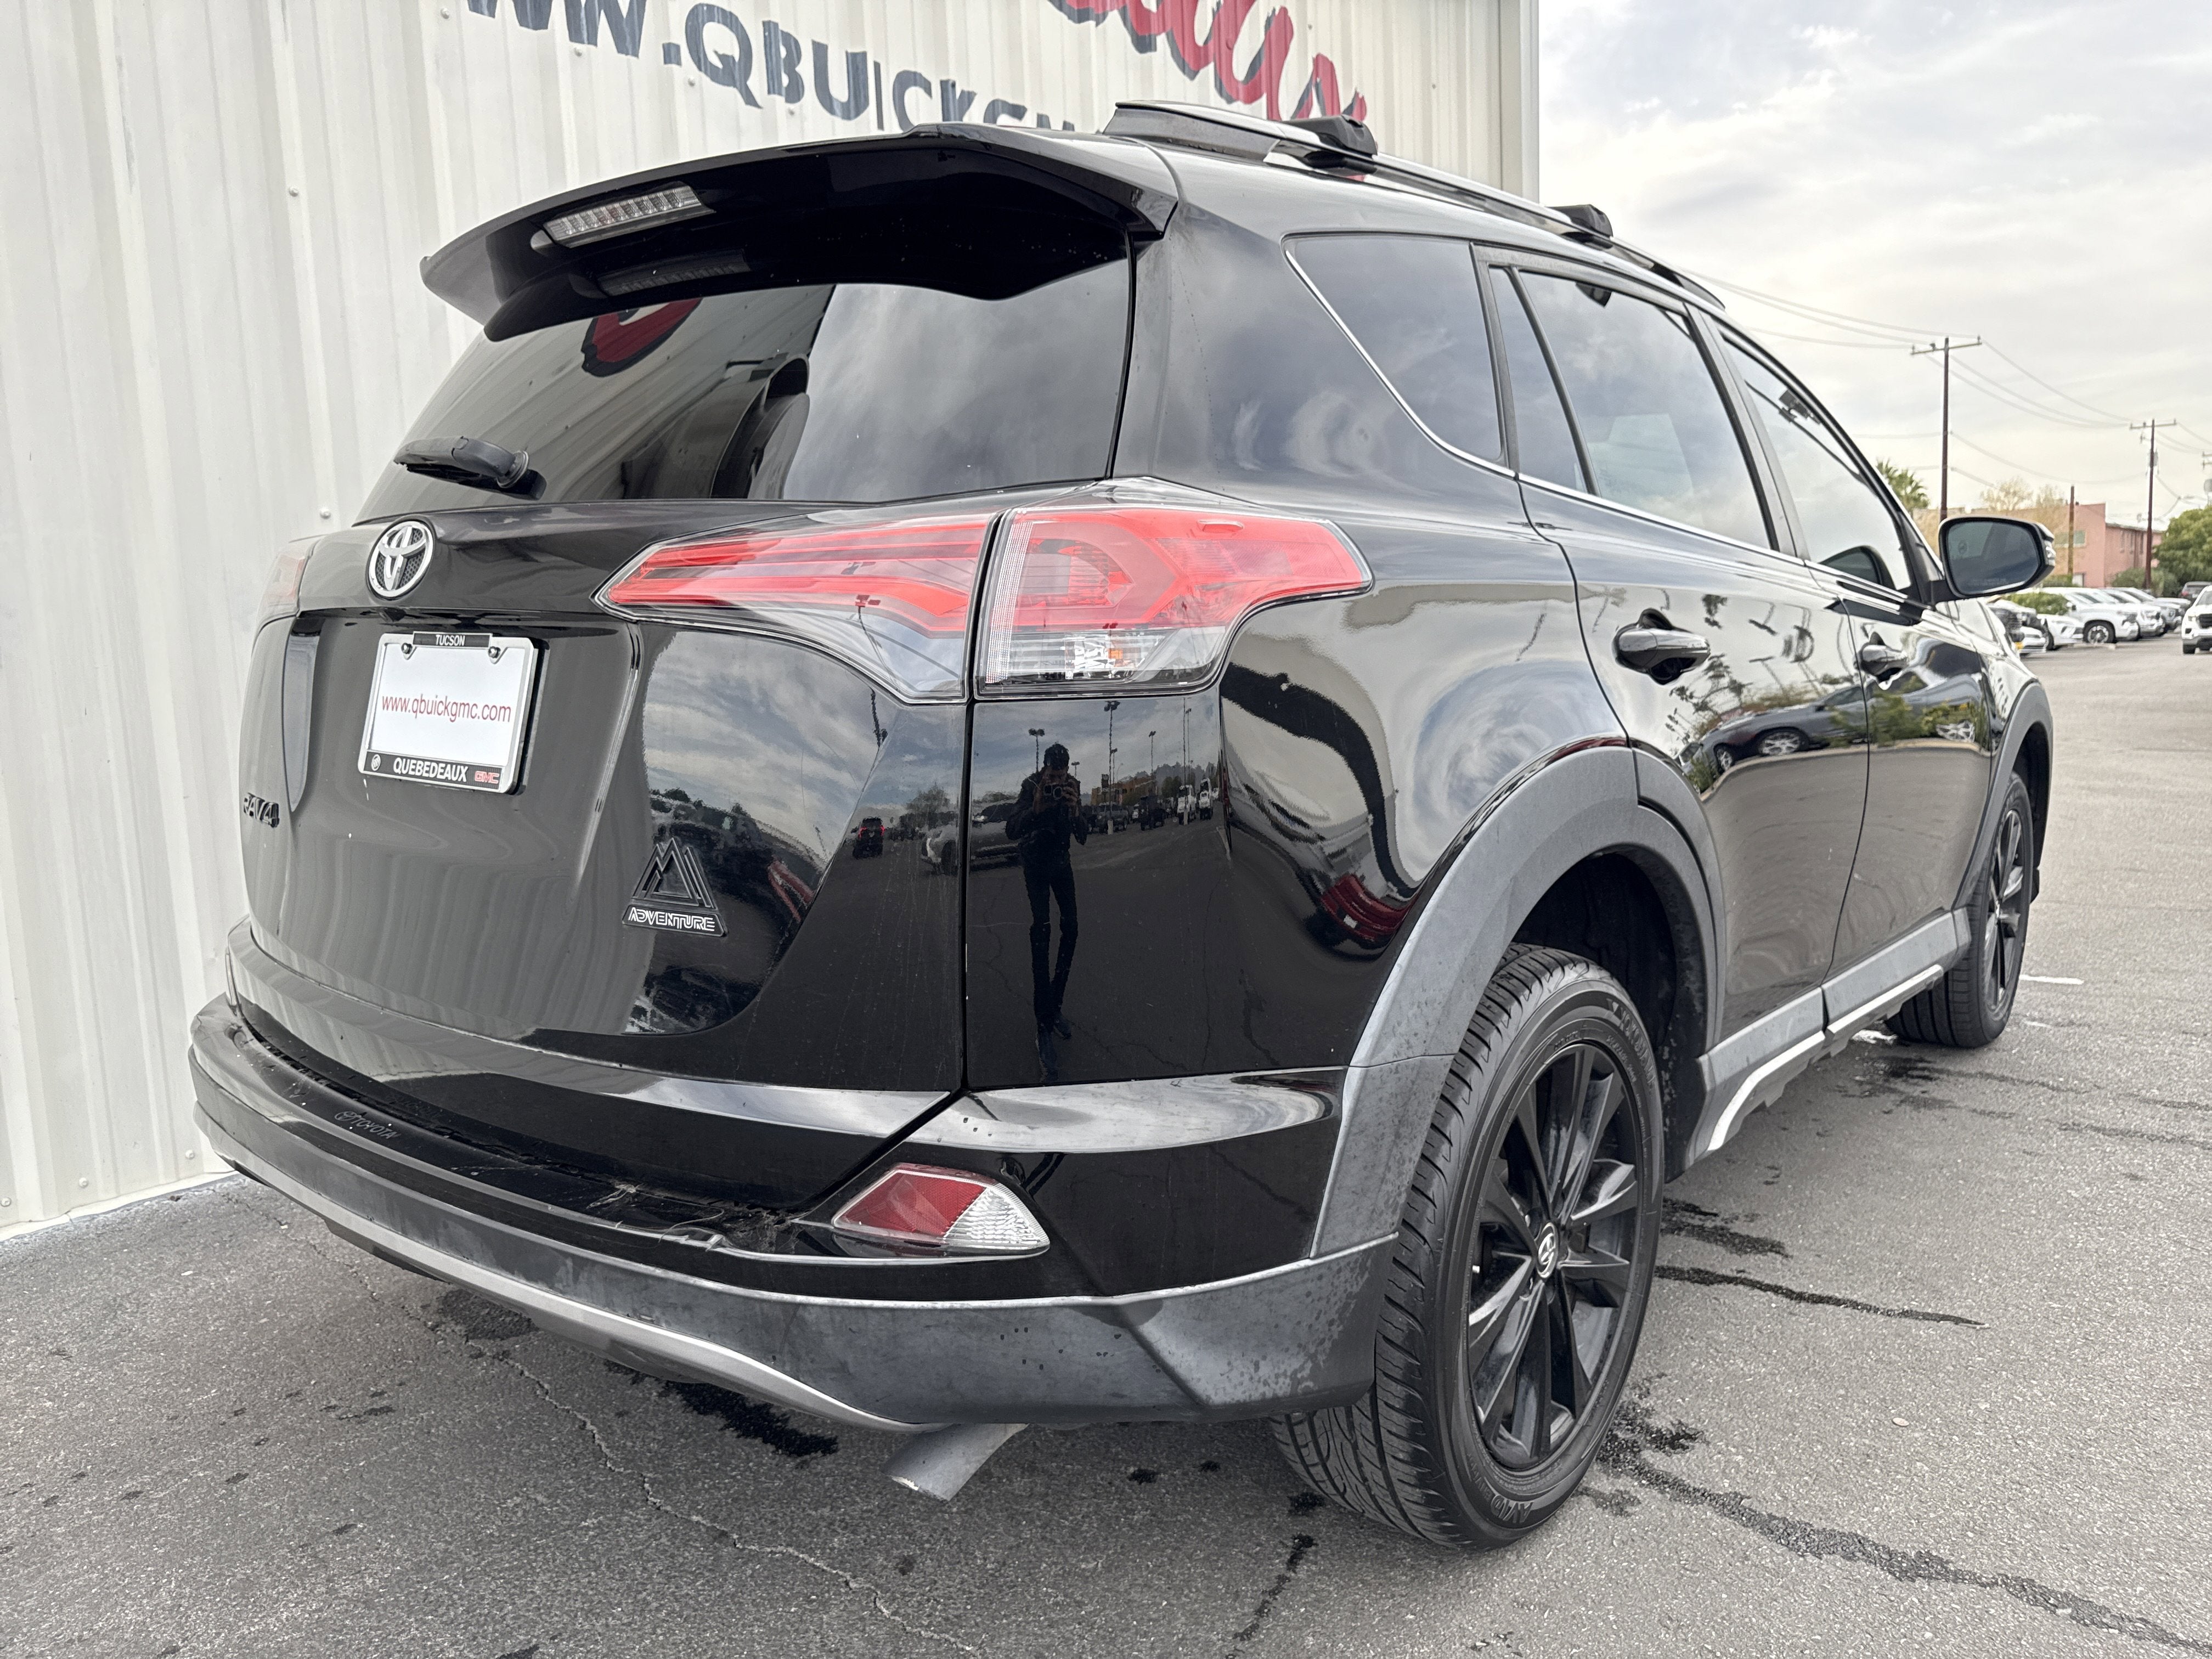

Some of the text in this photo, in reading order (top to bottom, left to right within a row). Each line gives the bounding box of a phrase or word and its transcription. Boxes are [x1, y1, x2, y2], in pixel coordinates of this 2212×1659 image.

[436, 634, 466, 646] TUCSON
[382, 693, 511, 723] www.qbuickgmc.com
[393, 757, 500, 785] QUEBEDEAUX GMC
[628, 907, 715, 932] ADVENTURE
[351, 1116, 398, 1139] TOYOTA
[1490, 1495, 1533, 1523] AVID
